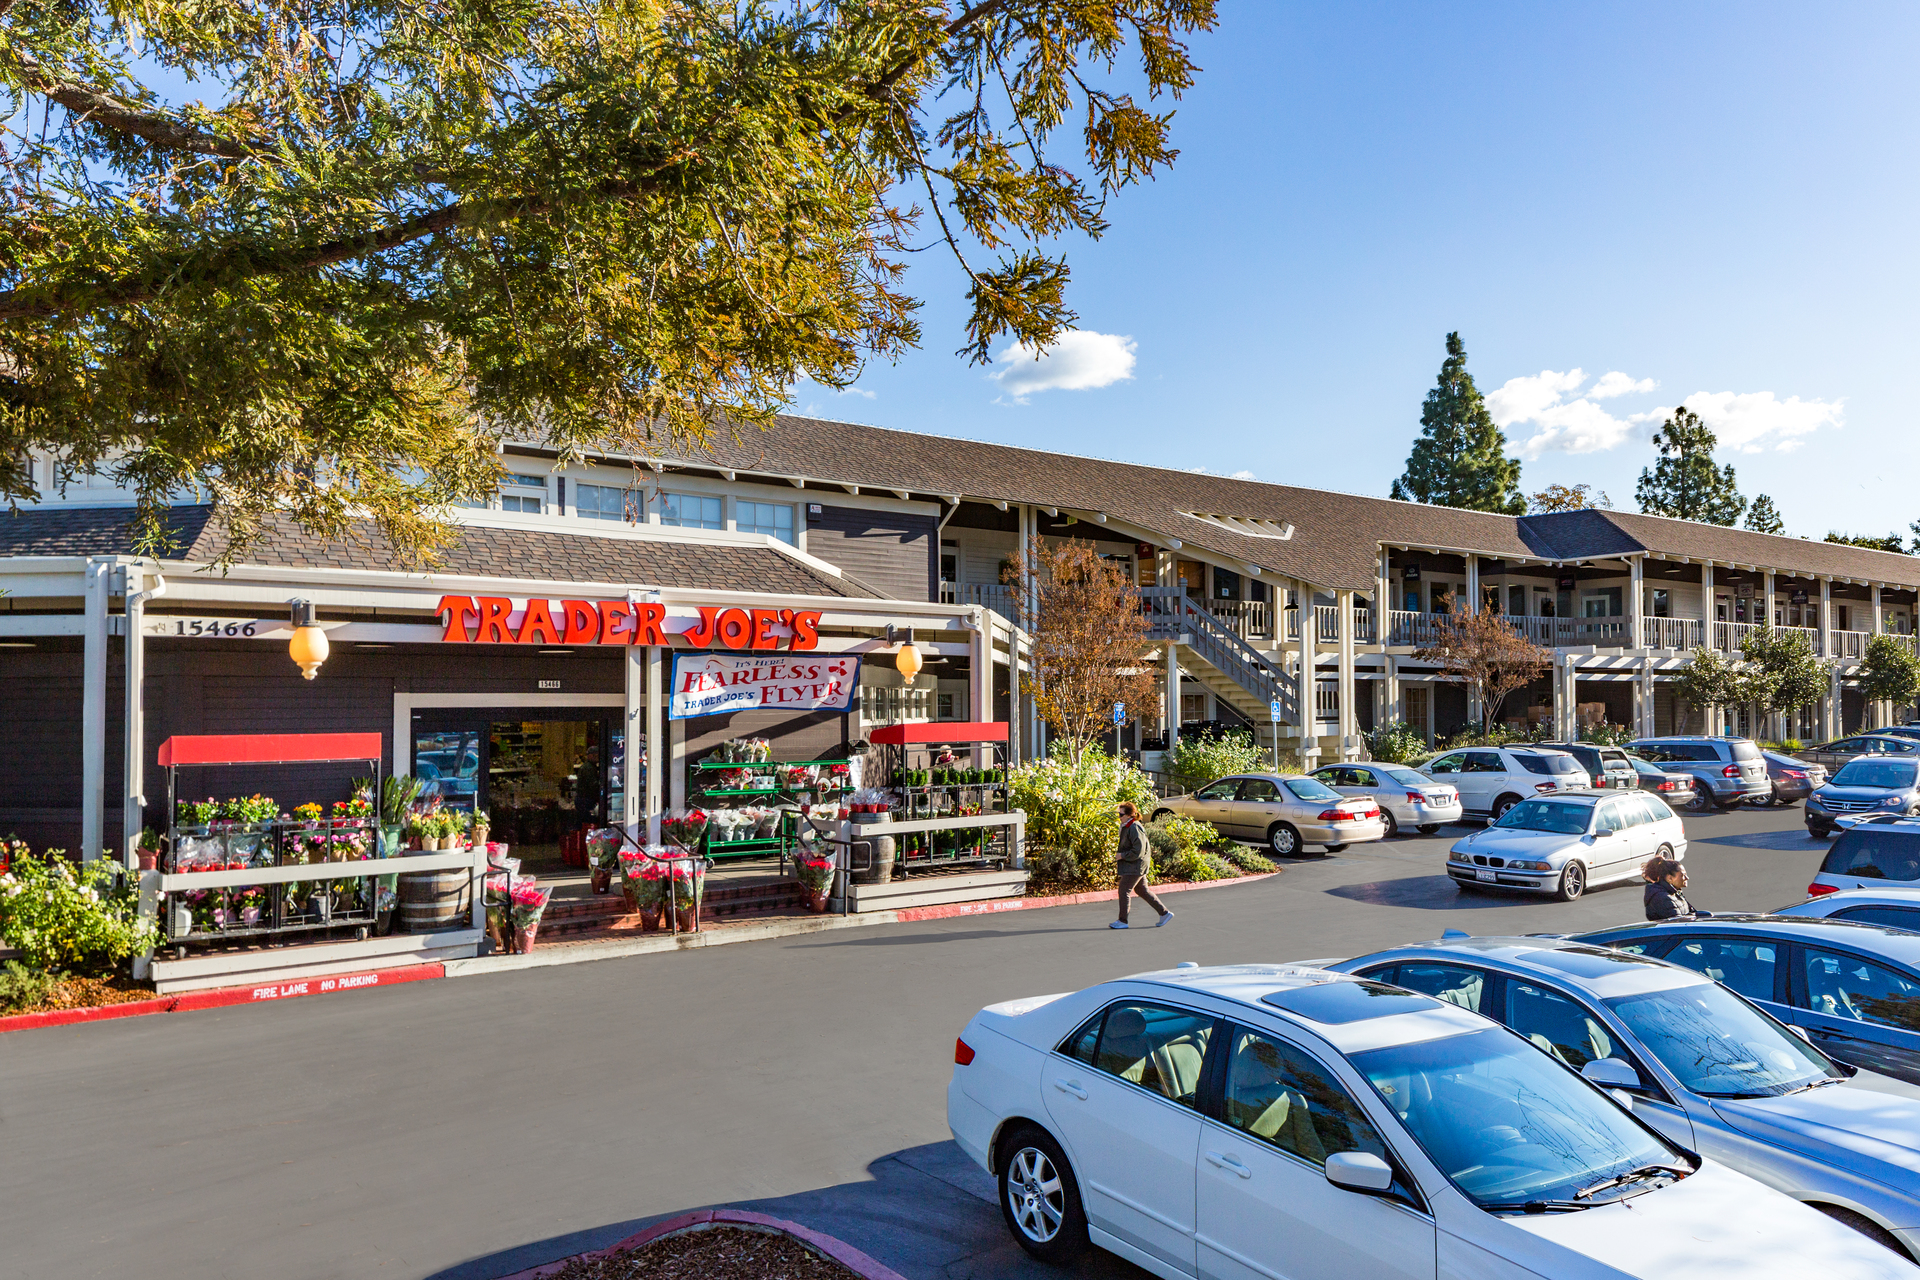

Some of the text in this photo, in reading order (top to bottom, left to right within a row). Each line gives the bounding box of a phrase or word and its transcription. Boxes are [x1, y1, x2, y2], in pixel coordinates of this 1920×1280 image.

[175, 619, 256, 637] 15466
[435, 595, 823, 650] TRADER JOE'S
[679, 664, 821, 694] FEARLESS
[684, 691, 755, 710] TRADER JOE'S
[759, 681, 844, 705] FLYER
[993, 902, 1001, 910] NO
[1002, 901, 1023, 909] PARKING
[253, 974, 378, 999] FIRE LANE NO PARKING
